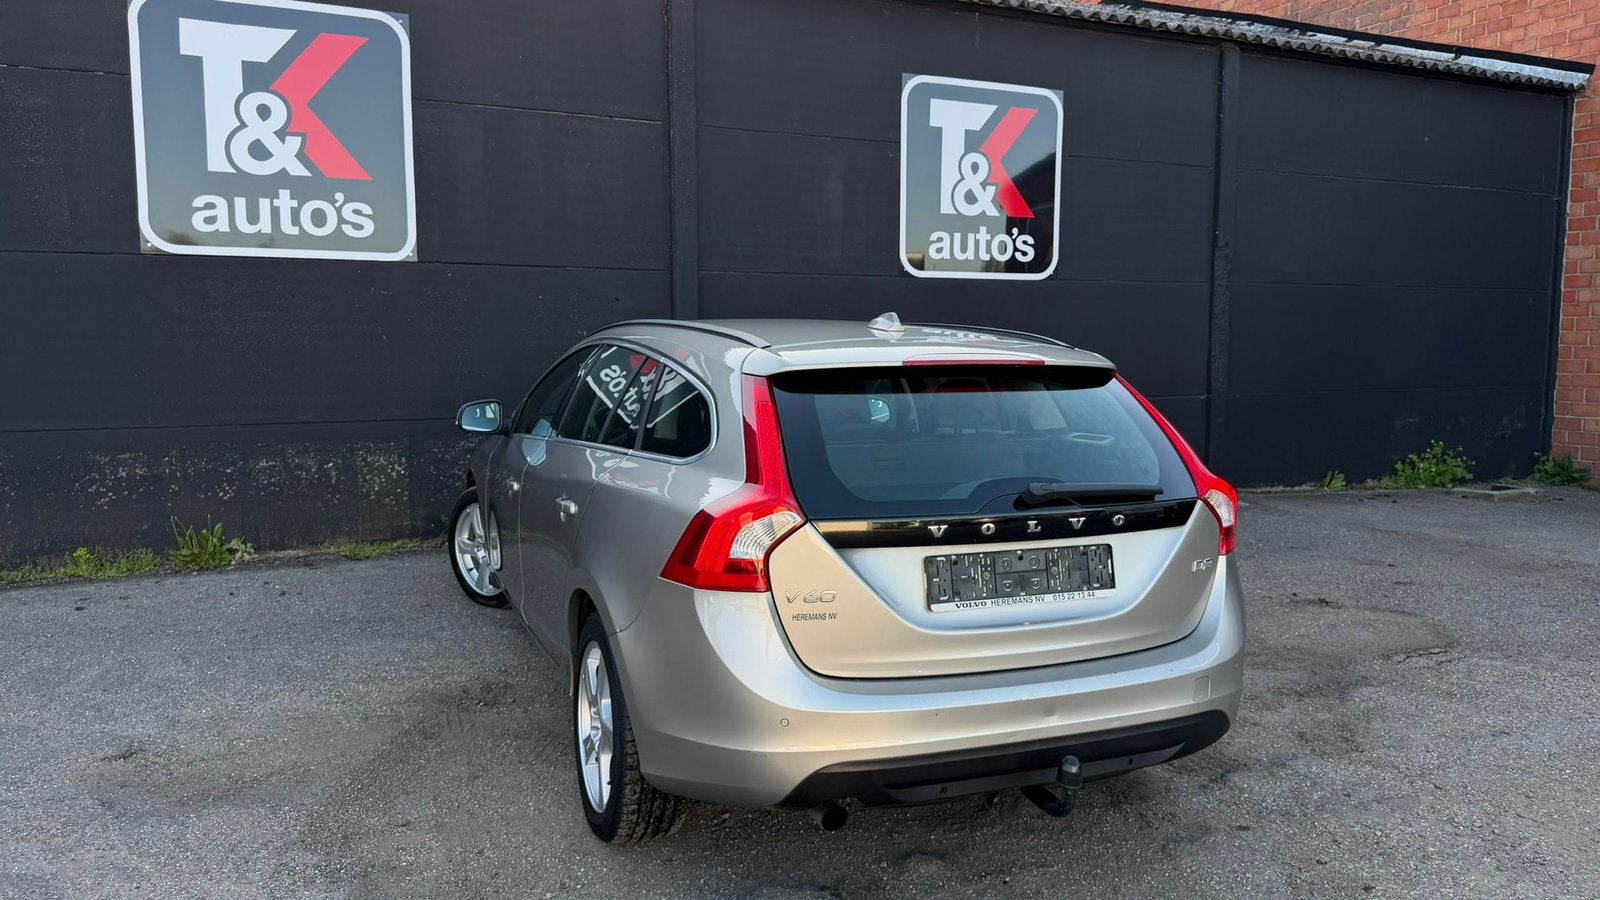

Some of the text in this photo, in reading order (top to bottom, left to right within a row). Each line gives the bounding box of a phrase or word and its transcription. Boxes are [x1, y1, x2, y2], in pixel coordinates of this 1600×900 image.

[179, 17, 373, 181] T&K
[929, 98, 1039, 219] T&K
[191, 189, 375, 238] auto's
[928, 226, 1035, 262] auto's
[928, 514, 1125, 538] VOLVO
[785, 589, 837, 604] V60
[955, 591, 1096, 609] VOLVO HEREMANS NV 015 22 13 44
[791, 612, 838, 621] HEREMANS NV
